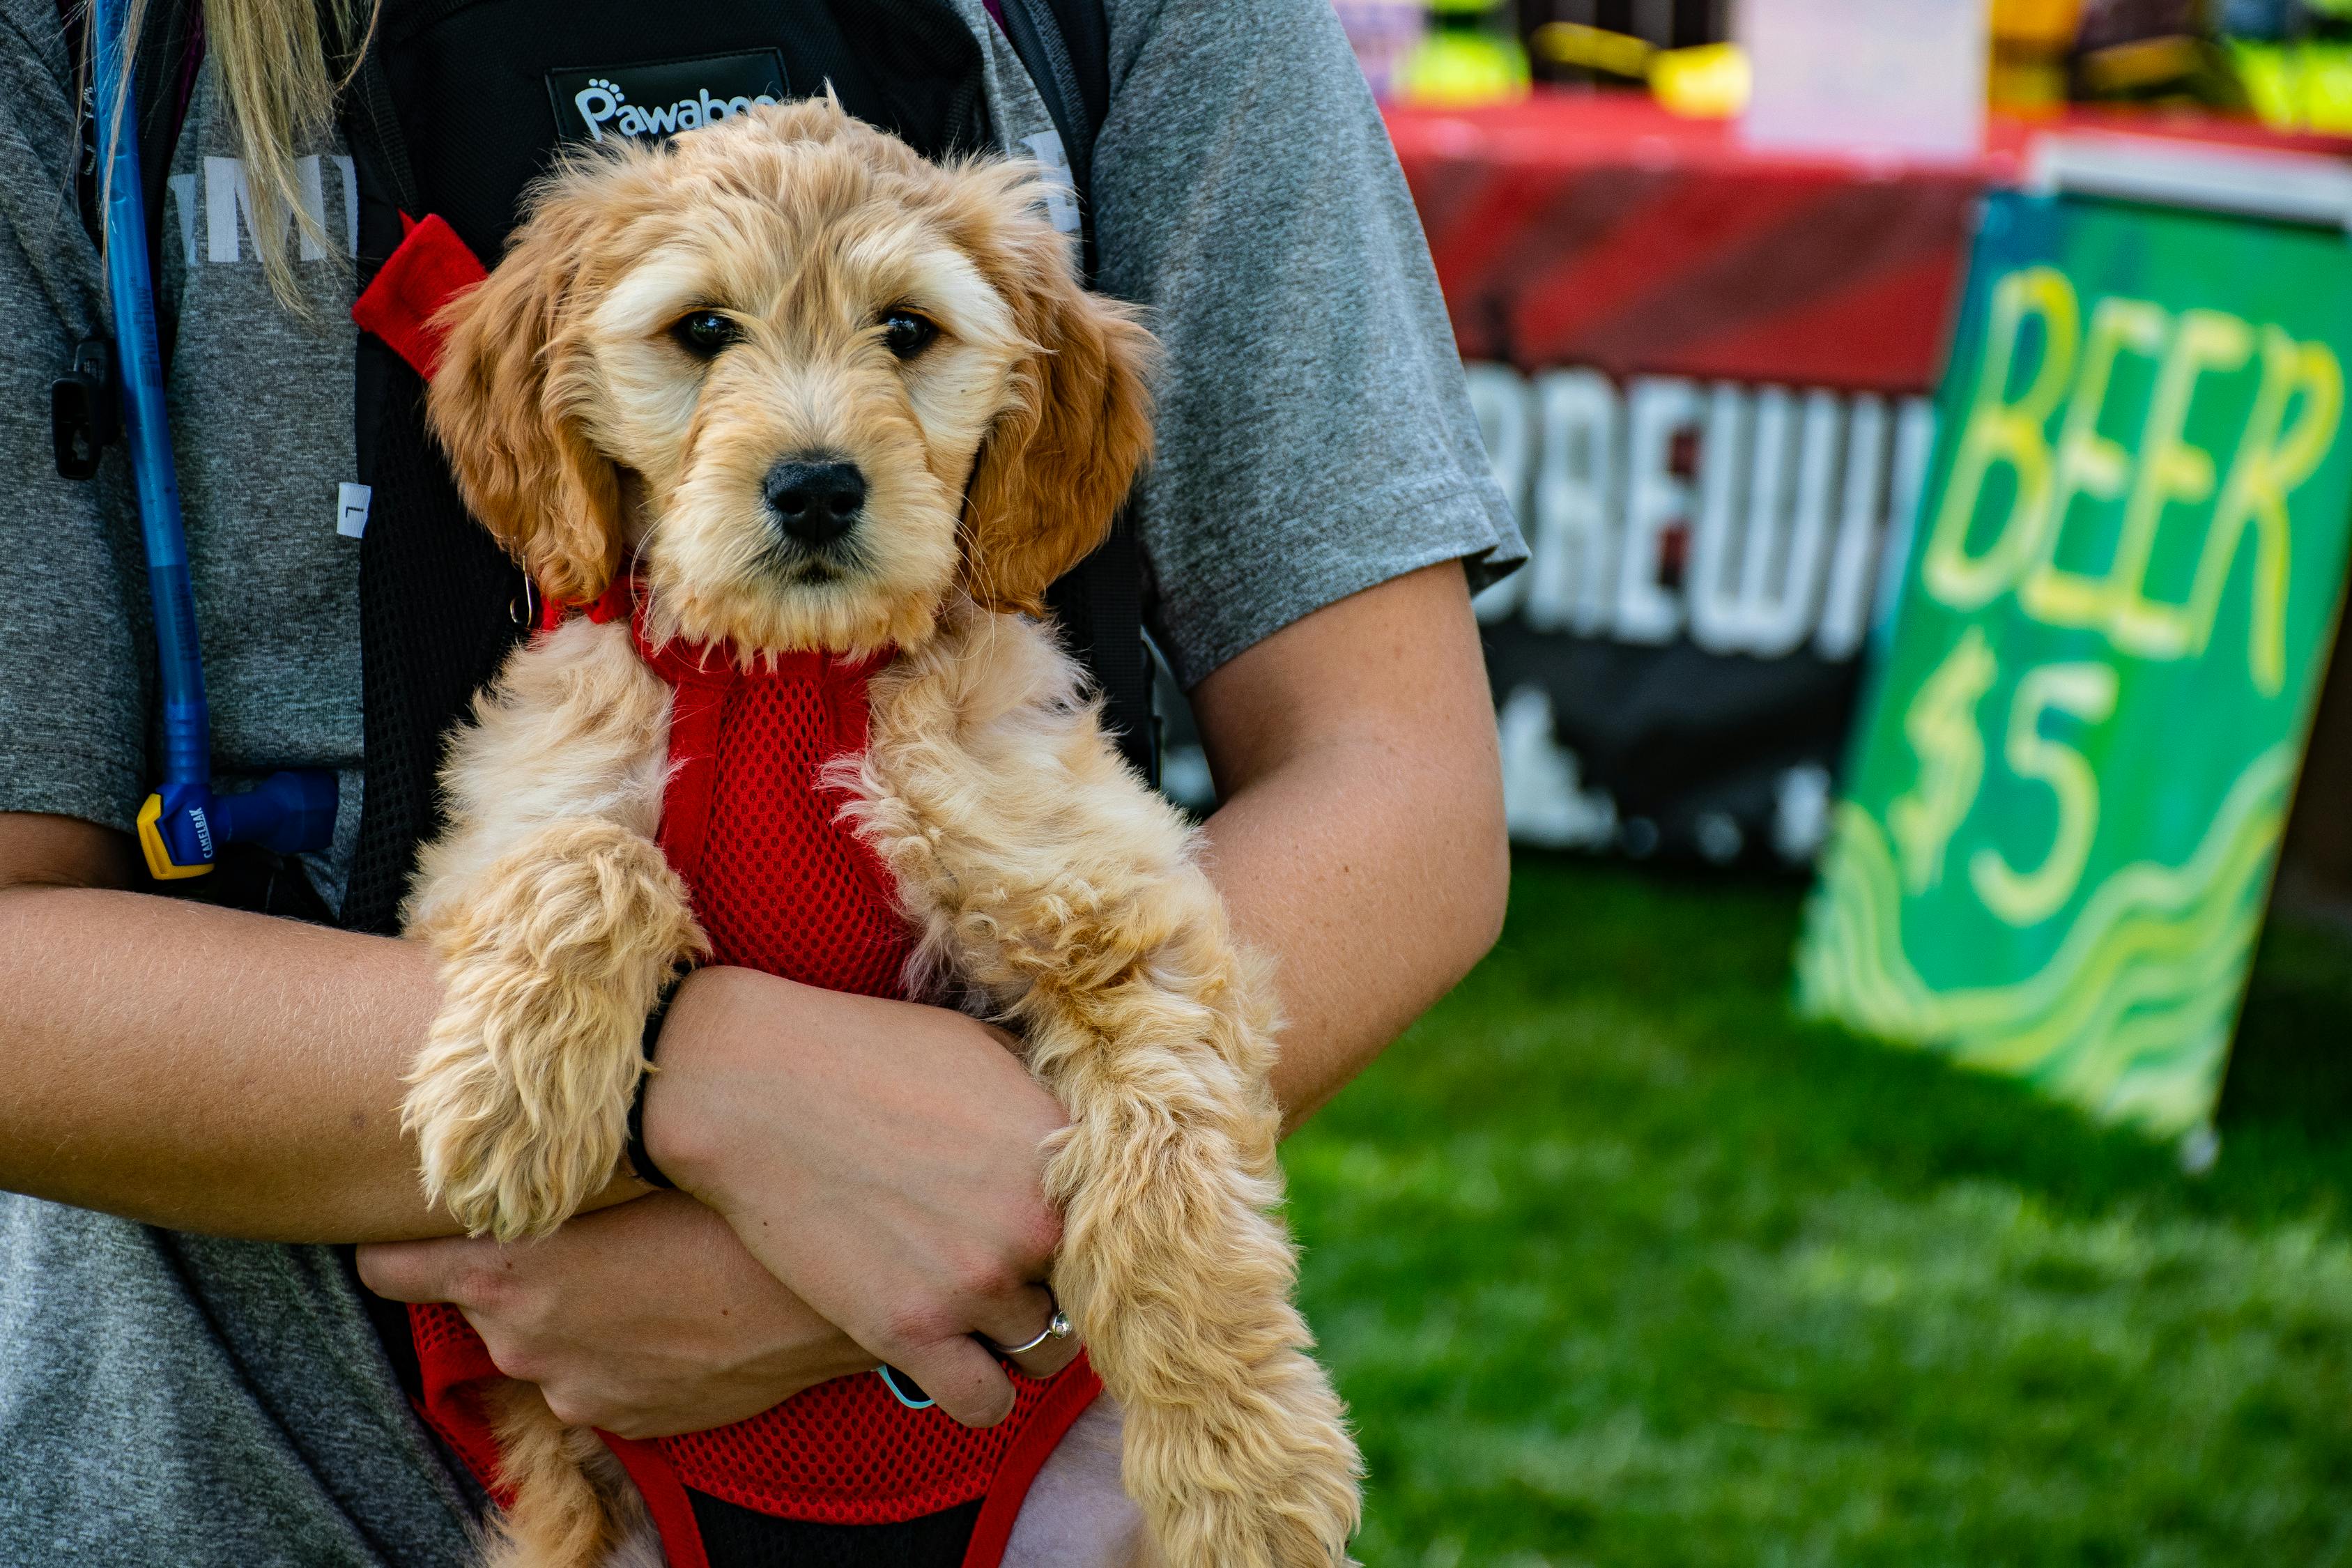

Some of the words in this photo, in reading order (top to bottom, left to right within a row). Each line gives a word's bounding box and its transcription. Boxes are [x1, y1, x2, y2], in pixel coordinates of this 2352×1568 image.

[574, 84, 764, 142] Pawabo
[1923, 266, 2344, 695] BEER
[345, 506, 364, 518] L
[1884, 625, 2120, 927] $5
[189, 807, 213, 859] CAMELBAK
